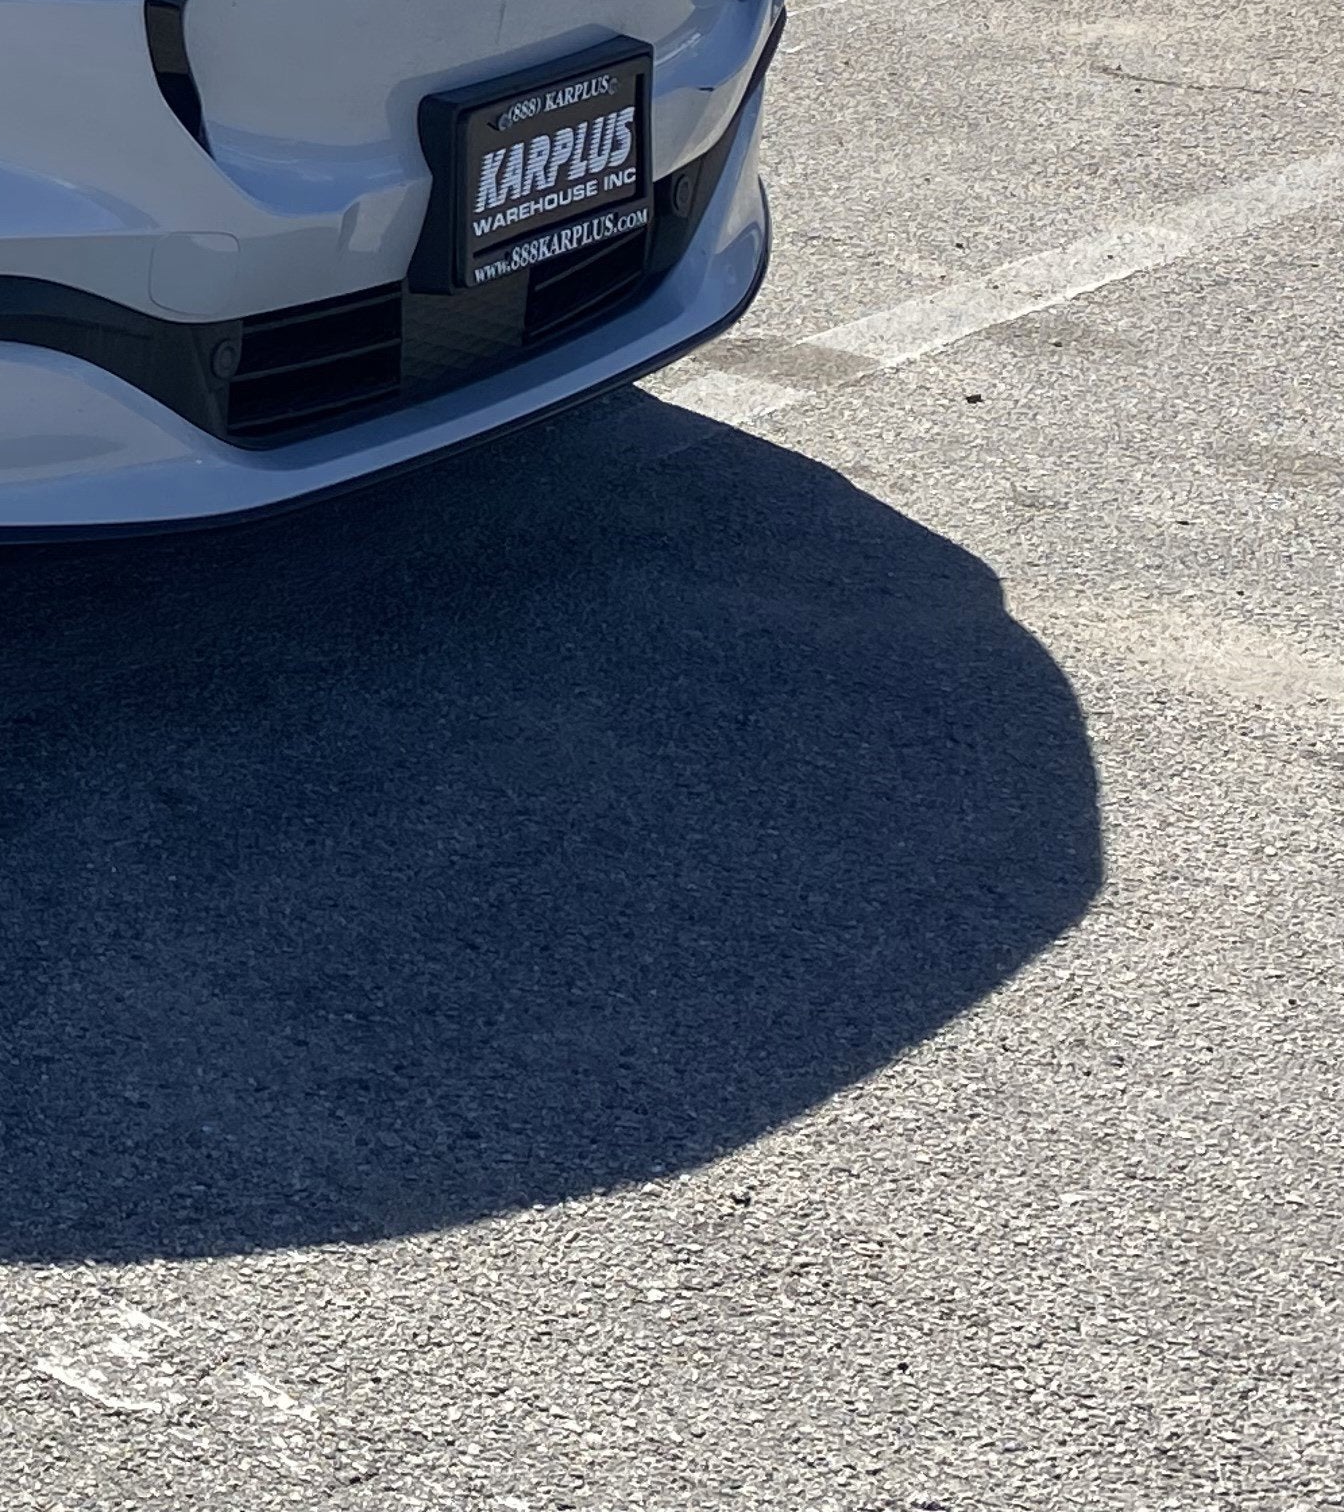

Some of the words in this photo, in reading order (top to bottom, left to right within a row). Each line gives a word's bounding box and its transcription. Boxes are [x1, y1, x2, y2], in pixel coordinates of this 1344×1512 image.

[543, 74, 610, 112] KARPLUS
[473, 105, 636, 214] KARPLUS
[473, 179, 599, 237] WAREHOUSE
[603, 166, 637, 192] INC
